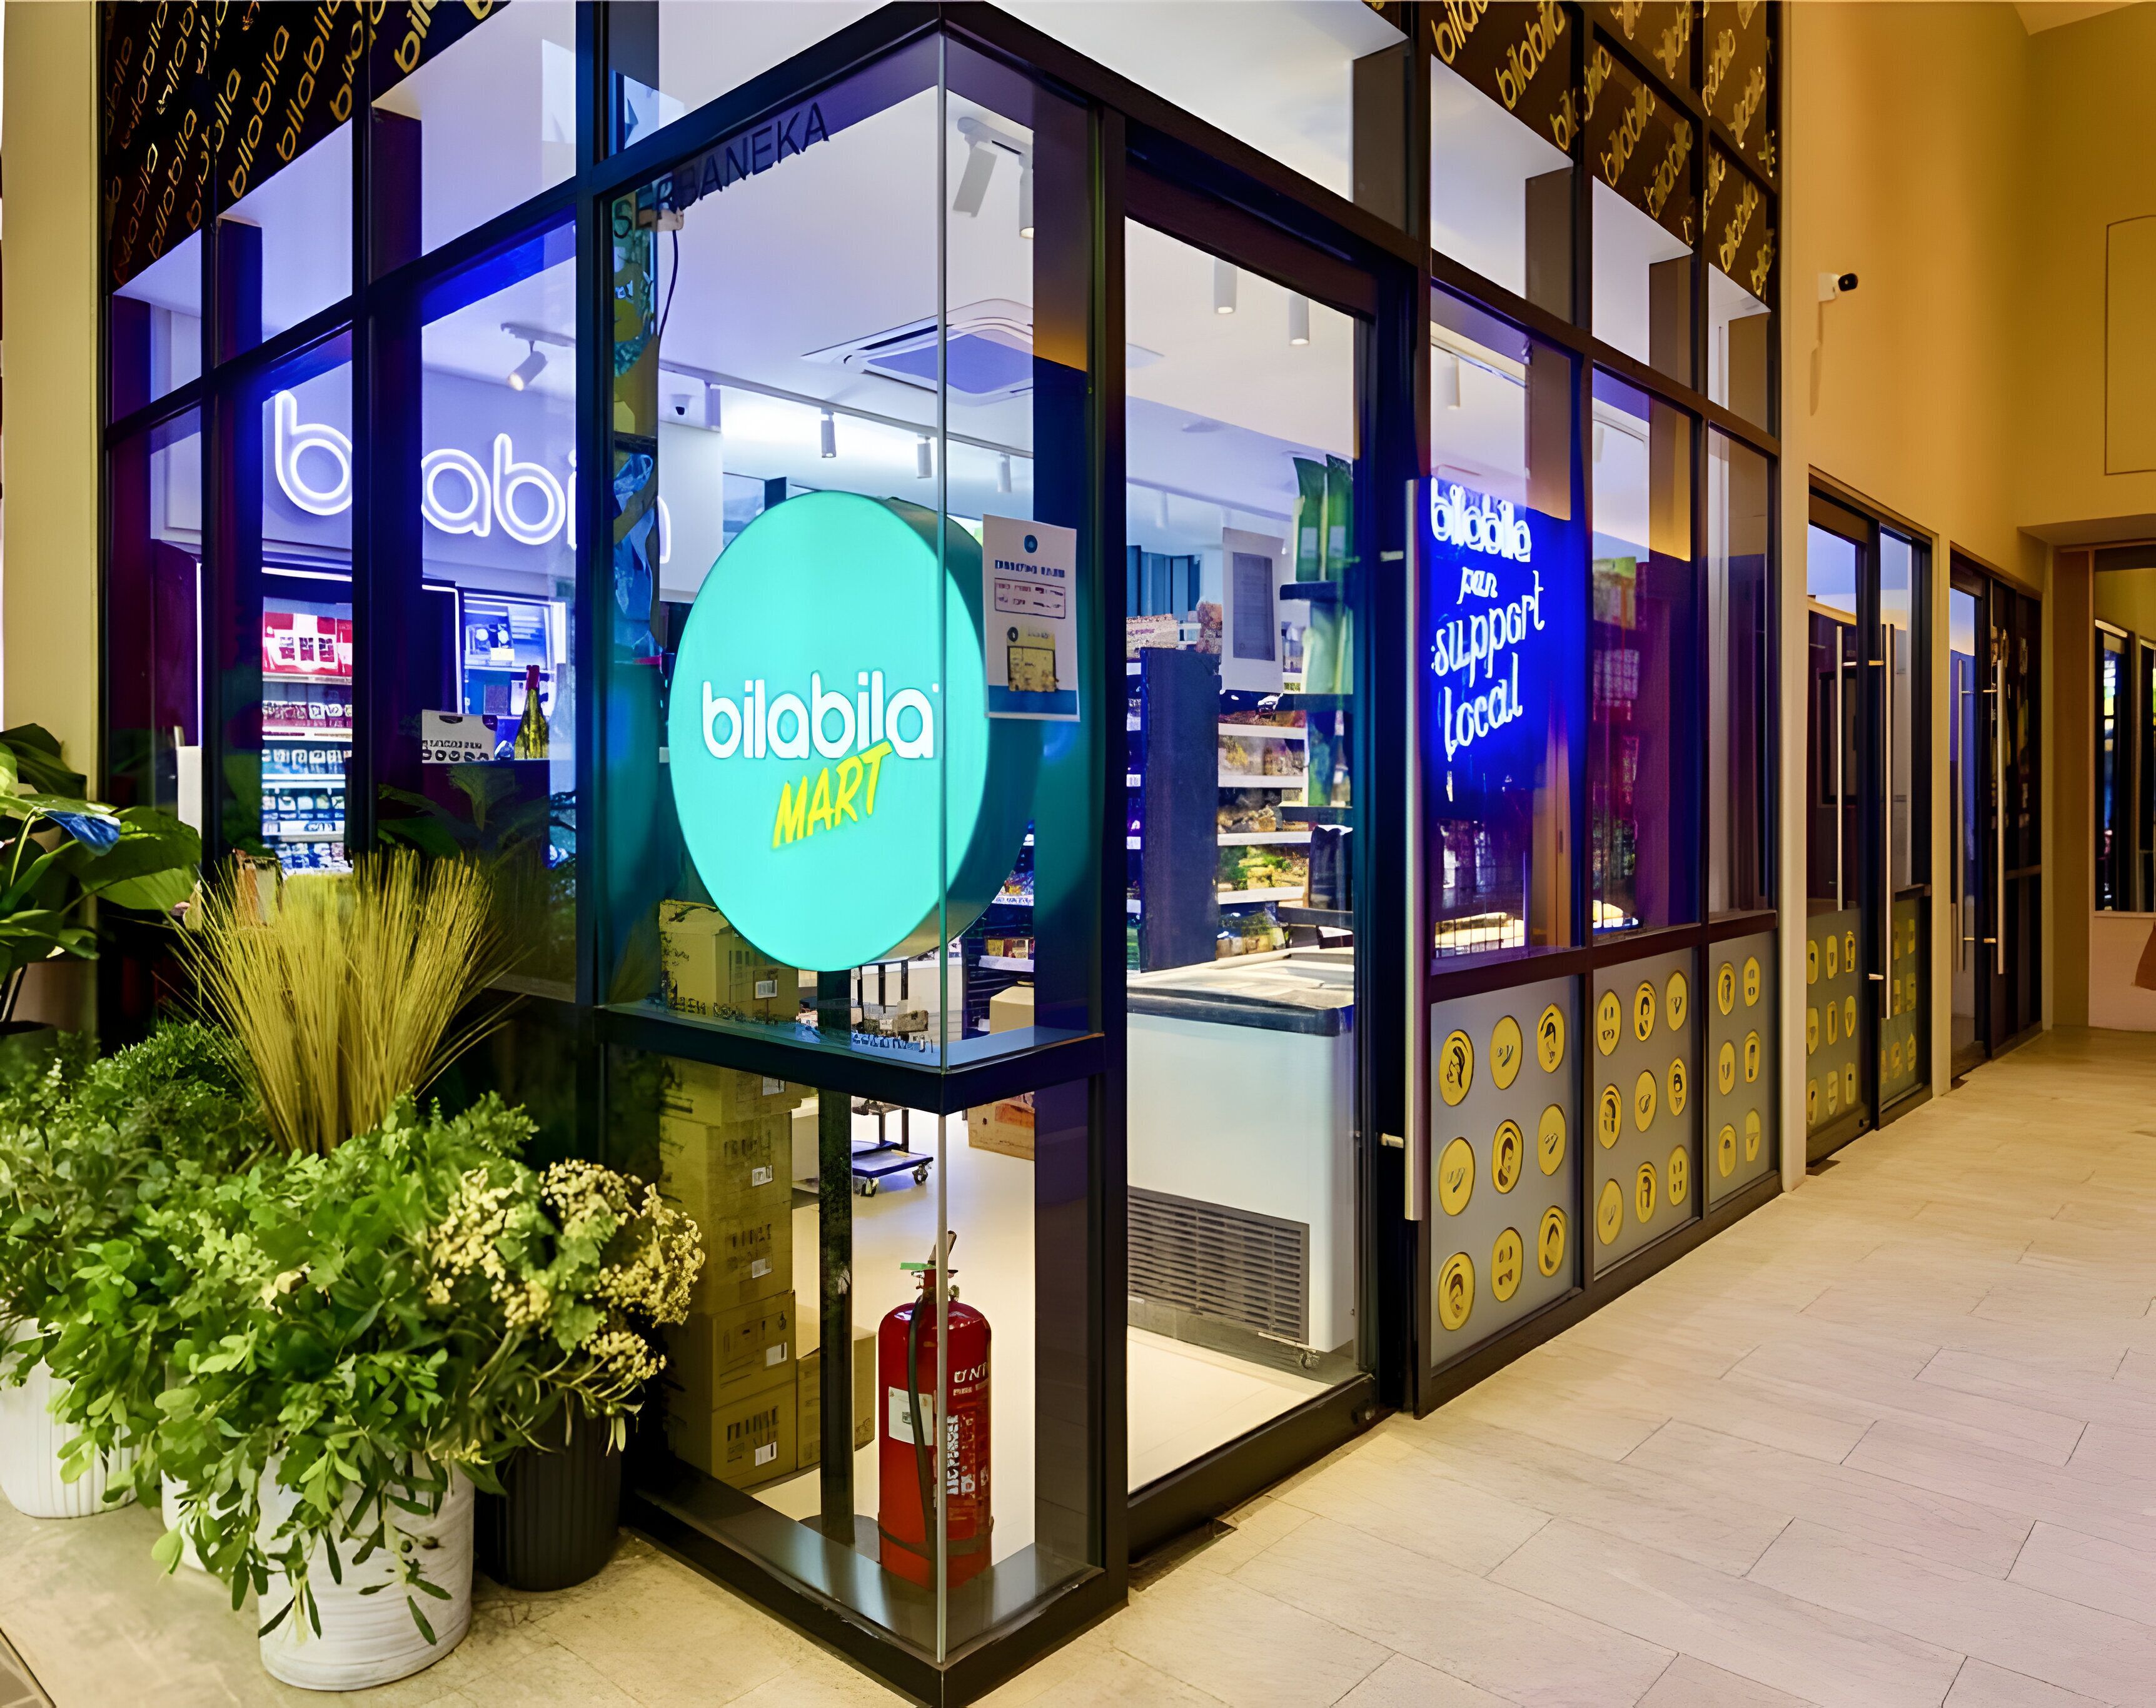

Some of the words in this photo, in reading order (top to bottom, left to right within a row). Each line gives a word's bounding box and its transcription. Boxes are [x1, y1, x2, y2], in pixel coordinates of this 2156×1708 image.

[1434, 570, 1545, 688] support
[702, 669, 935, 760] bilabila
[772, 740, 894, 849] MART
